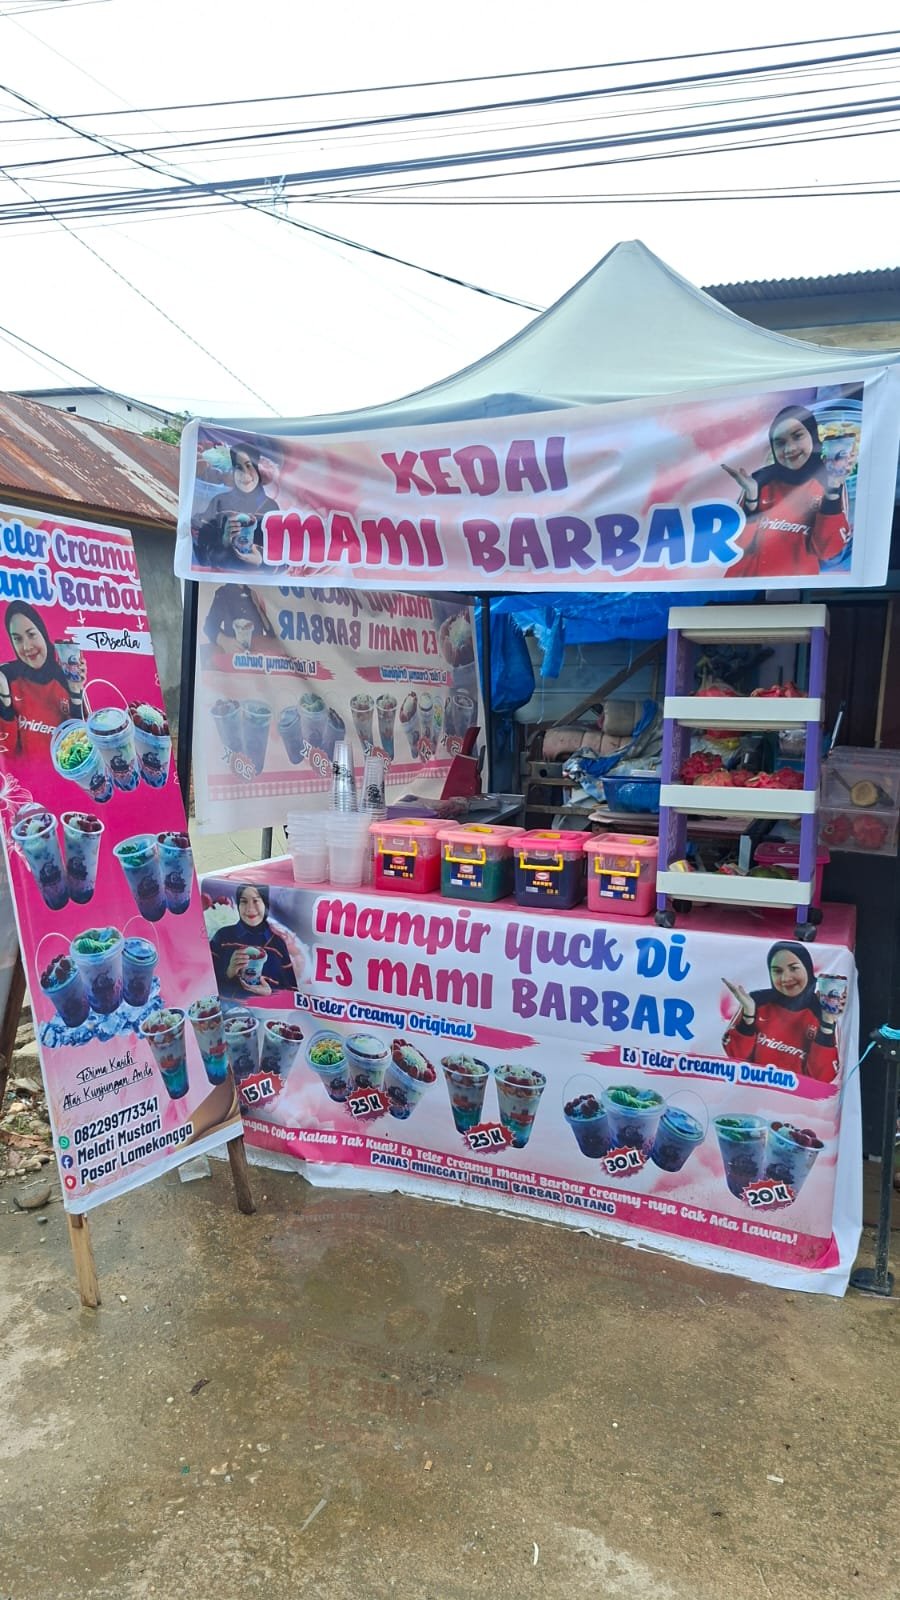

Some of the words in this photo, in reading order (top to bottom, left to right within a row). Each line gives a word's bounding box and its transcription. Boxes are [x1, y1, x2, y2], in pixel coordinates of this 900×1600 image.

[381, 436, 567, 498] KEDAI
[265, 511, 445, 566] MAMI
[464, 503, 741, 572] BARBAR
[86, 631, 141, 650] Tersedia
[316, 899, 491, 955] Mampir
[505, 922, 623, 975] Yuck
[636, 934, 691, 982] Di
[296, 993, 309, 1009] Es
[312, 998, 345, 1017] Teler
[349, 1005, 405, 1031] Creamy
[409, 1014, 475, 1039] Original
[315, 947, 353, 987] ES
[368, 958, 493, 1010] MAMI
[511, 978, 695, 1041] BARBAR
[108, 1050, 134, 1070] Kasih
[623, 1047, 637, 1063] Es
[641, 1050, 675, 1069] Teler
[678, 1056, 736, 1082] Creamy
[740, 1065, 796, 1088] Durian
[83, 1077, 128, 1102] Kunjungan
[242, 1081, 260, 1102] 15
[351, 1096, 371, 1116] 25
[74, 1097, 159, 1146] 082299773341
[77, 1134, 115, 1167] Melati
[117, 1114, 162, 1154] Mustari
[469, 1130, 491, 1149] 25
[81, 1158, 118, 1185] Pasar
[120, 1123, 193, 1167] Lamekongga
[605, 1156, 628, 1173] 30
[271, 1125, 297, 1141] Coba
[299, 1130, 338, 1145] Kalau
[341, 1134, 364, 1148] Tak
[366, 1139, 399, 1154] Kuat!
[417, 1149, 443, 1163] Teler
[446, 1156, 493, 1177] Creamy
[496, 1168, 537, 1185] Mami
[540, 1176, 586, 1194] Barbar
[589, 1186, 641, 1209] Creamy
[680, 1206, 707, 1223] Gak
[709, 1214, 740, 1231] Ada
[742, 1222, 798, 1246] Lawan!
[372, 1153, 408, 1168] PANAS
[471, 1174, 508, 1190] MAMI
[512, 1182, 561, 1202] BARBAR
[563, 1194, 615, 1214] DATANG
[748, 1188, 774, 1206] 20
